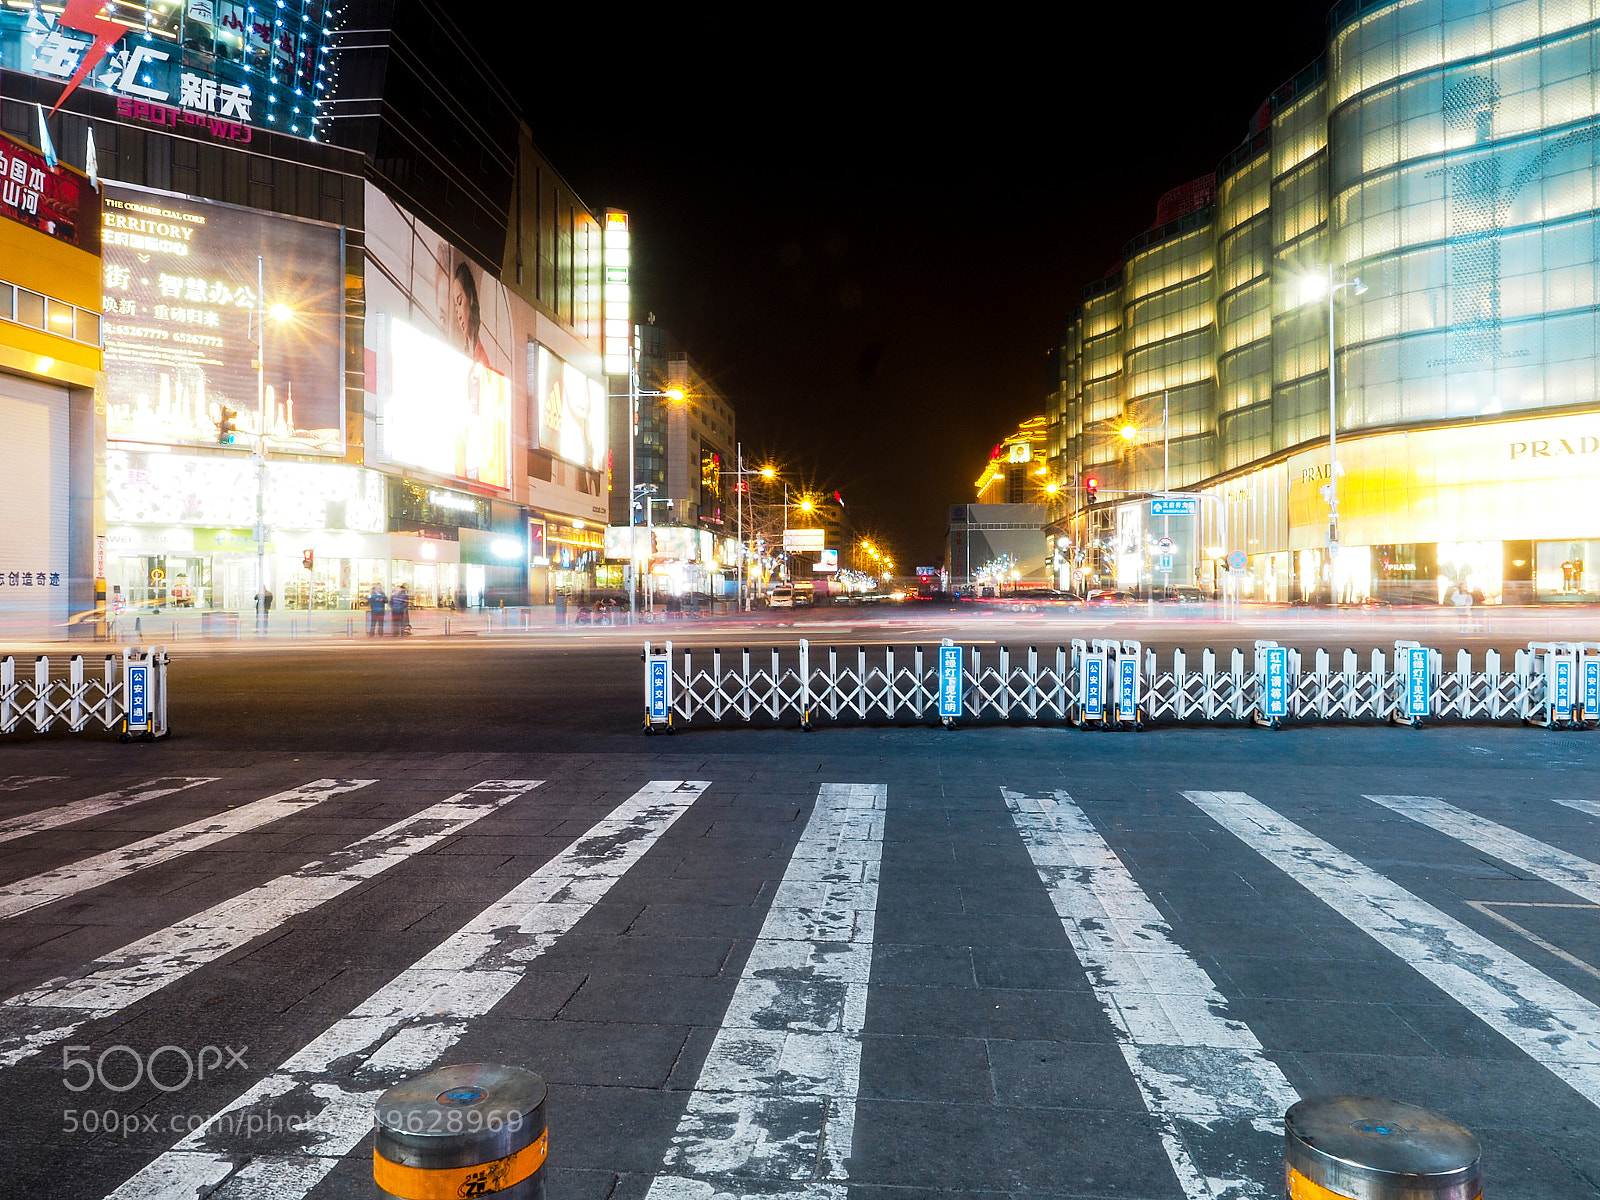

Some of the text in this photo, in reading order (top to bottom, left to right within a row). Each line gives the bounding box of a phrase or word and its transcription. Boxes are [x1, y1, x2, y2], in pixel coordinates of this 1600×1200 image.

[117, 96, 253, 143] SPOT on WFJ
[102, 212, 194, 241] ERRITORY
[104, 198, 206, 225] THE COMMERCIAL CORE
[172, 331, 224, 348] 65267772
[1387, 563, 1417, 571] PRADA
[133, 673, 143, 717] 公安交通
[654, 666, 664, 710] 公安交通
[945, 650, 957, 713] 红绿灯下见文明
[1089, 664, 1099, 707] 公安交通
[1123, 665, 1133, 707] 公安交通
[1412, 651, 1425, 712] 红绿灯下见文明
[1558, 666, 1568, 707] 公安交通
[1587, 666, 1597, 707] 公安交通
